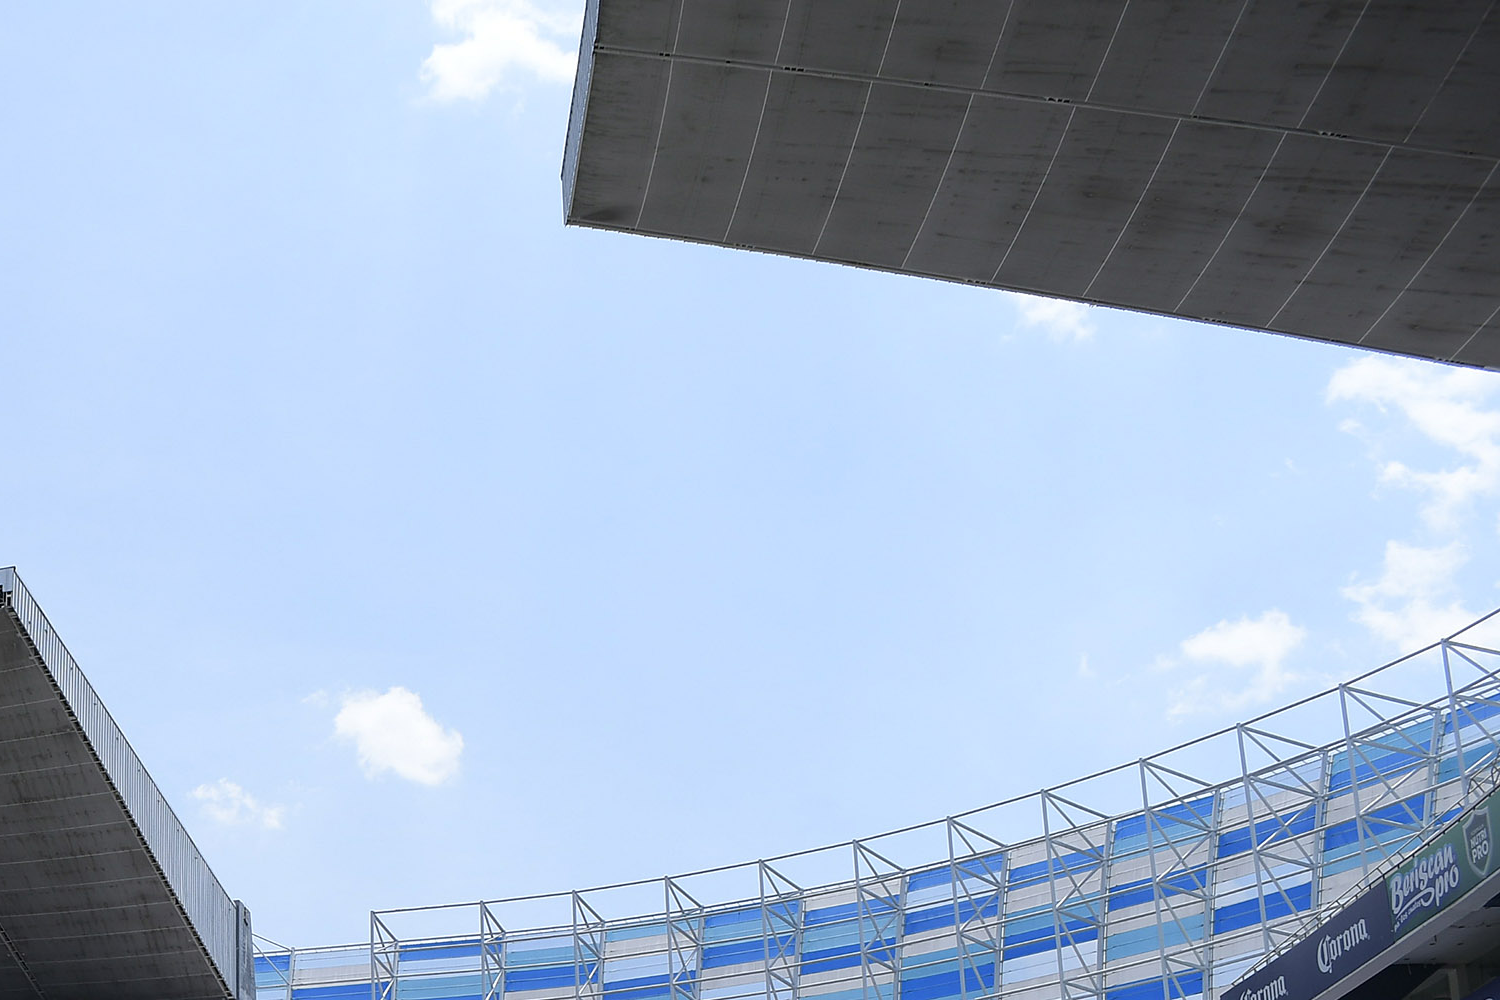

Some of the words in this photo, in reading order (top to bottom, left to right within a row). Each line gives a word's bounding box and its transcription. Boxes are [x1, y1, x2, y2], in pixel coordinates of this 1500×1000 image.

[1471, 840, 1489, 864] PRO
[1390, 843, 1454, 914] Beriscan
[1435, 864, 1459, 907] pro
[1316, 917, 1369, 974] Corona
